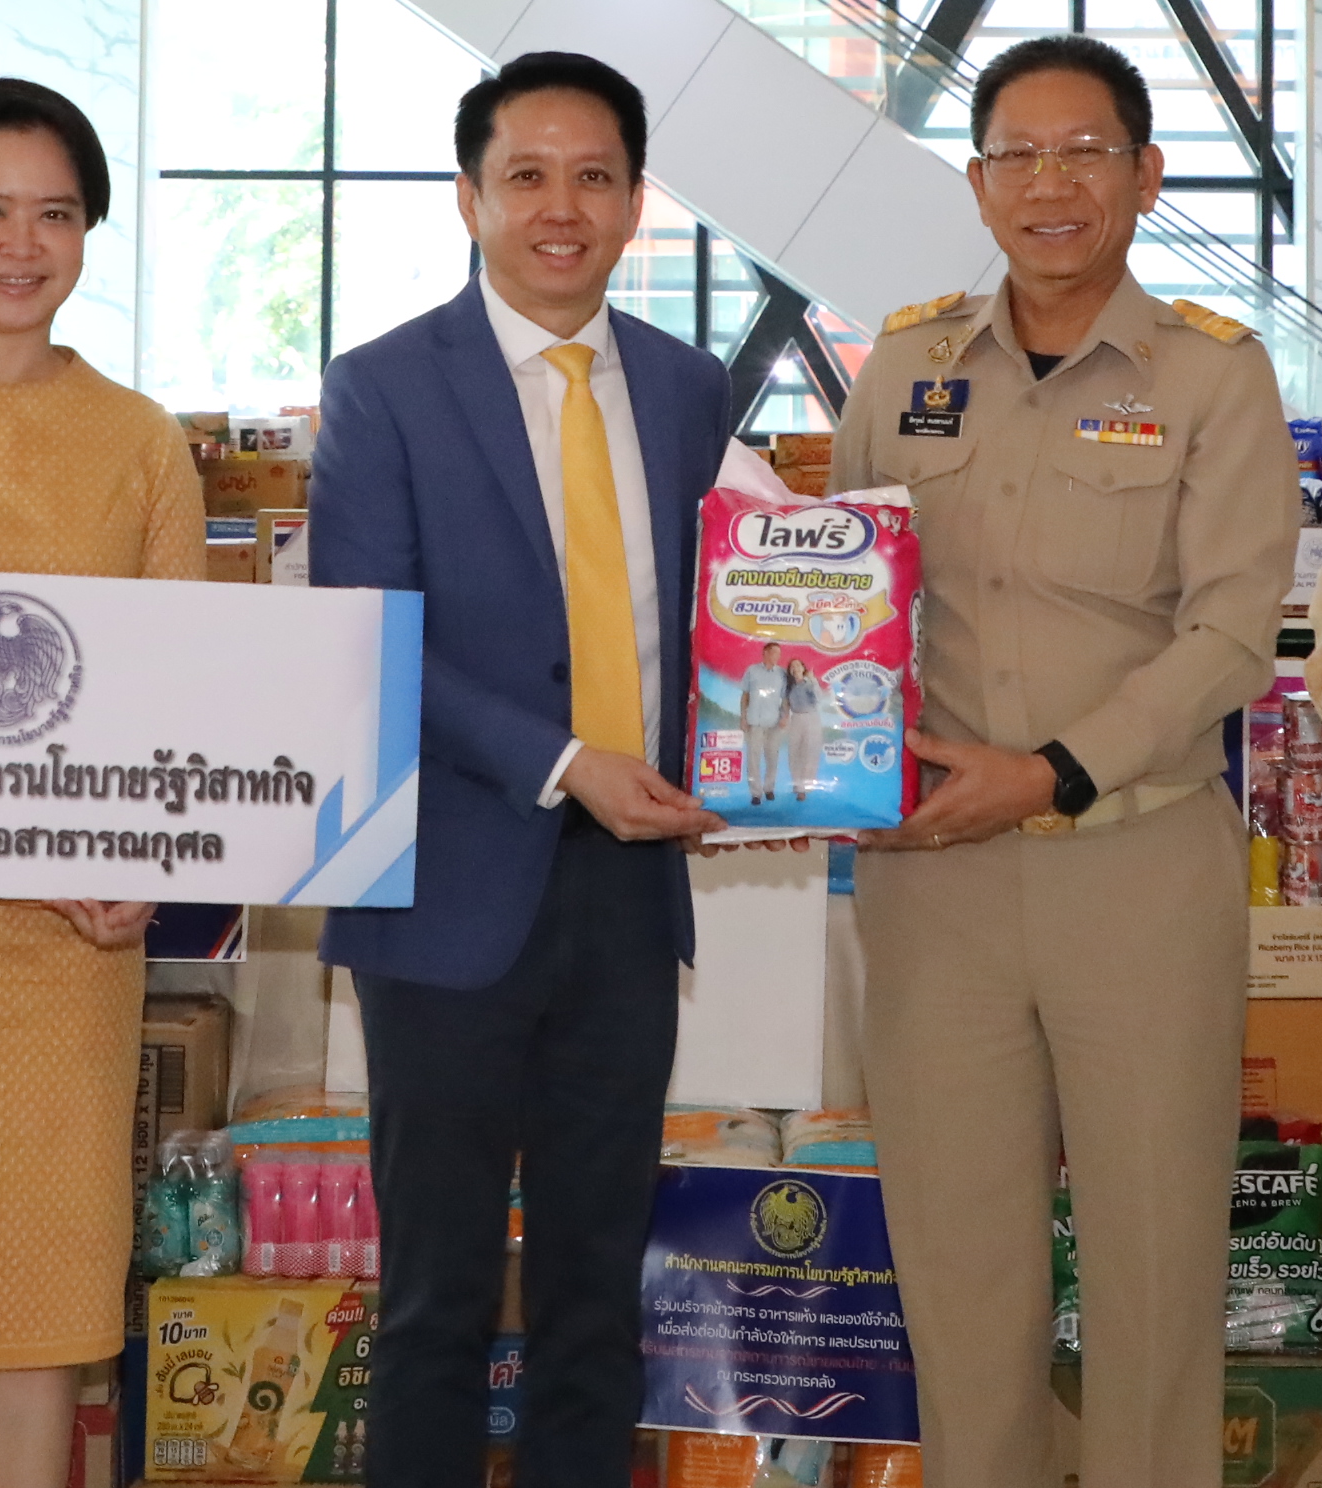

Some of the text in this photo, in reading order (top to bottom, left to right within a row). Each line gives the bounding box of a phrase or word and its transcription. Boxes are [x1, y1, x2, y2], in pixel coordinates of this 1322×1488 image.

[726, 568, 873, 589] กางเกงซึมซับสบาย
[734, 599, 792, 614] สวมง่าย
[1294, 944, 1310, 952] Rice
[134, 1155, 149, 1174] 12
[1231, 1163, 1319, 1196] ESCAFÉ
[1231, 1199, 1257, 1208] LEND
[1271, 1198, 1302, 1208] BREW
[1231, 1256, 1272, 1279] ยเร็ว
[172, 1311, 194, 1320] ขนาด
[654, 1296, 756, 1317] ร่วมบริจาคข้าวสาร
[759, 1305, 817, 1323] อาหารแห้ง
[657, 1320, 900, 1351] เพื่อส่งต่อเป็นกำลังใจให้ทหาร และประชาชน
[338, 1367, 371, 1388] อิชิ
[734, 1371, 836, 1388] กระทรวงการคลัง
